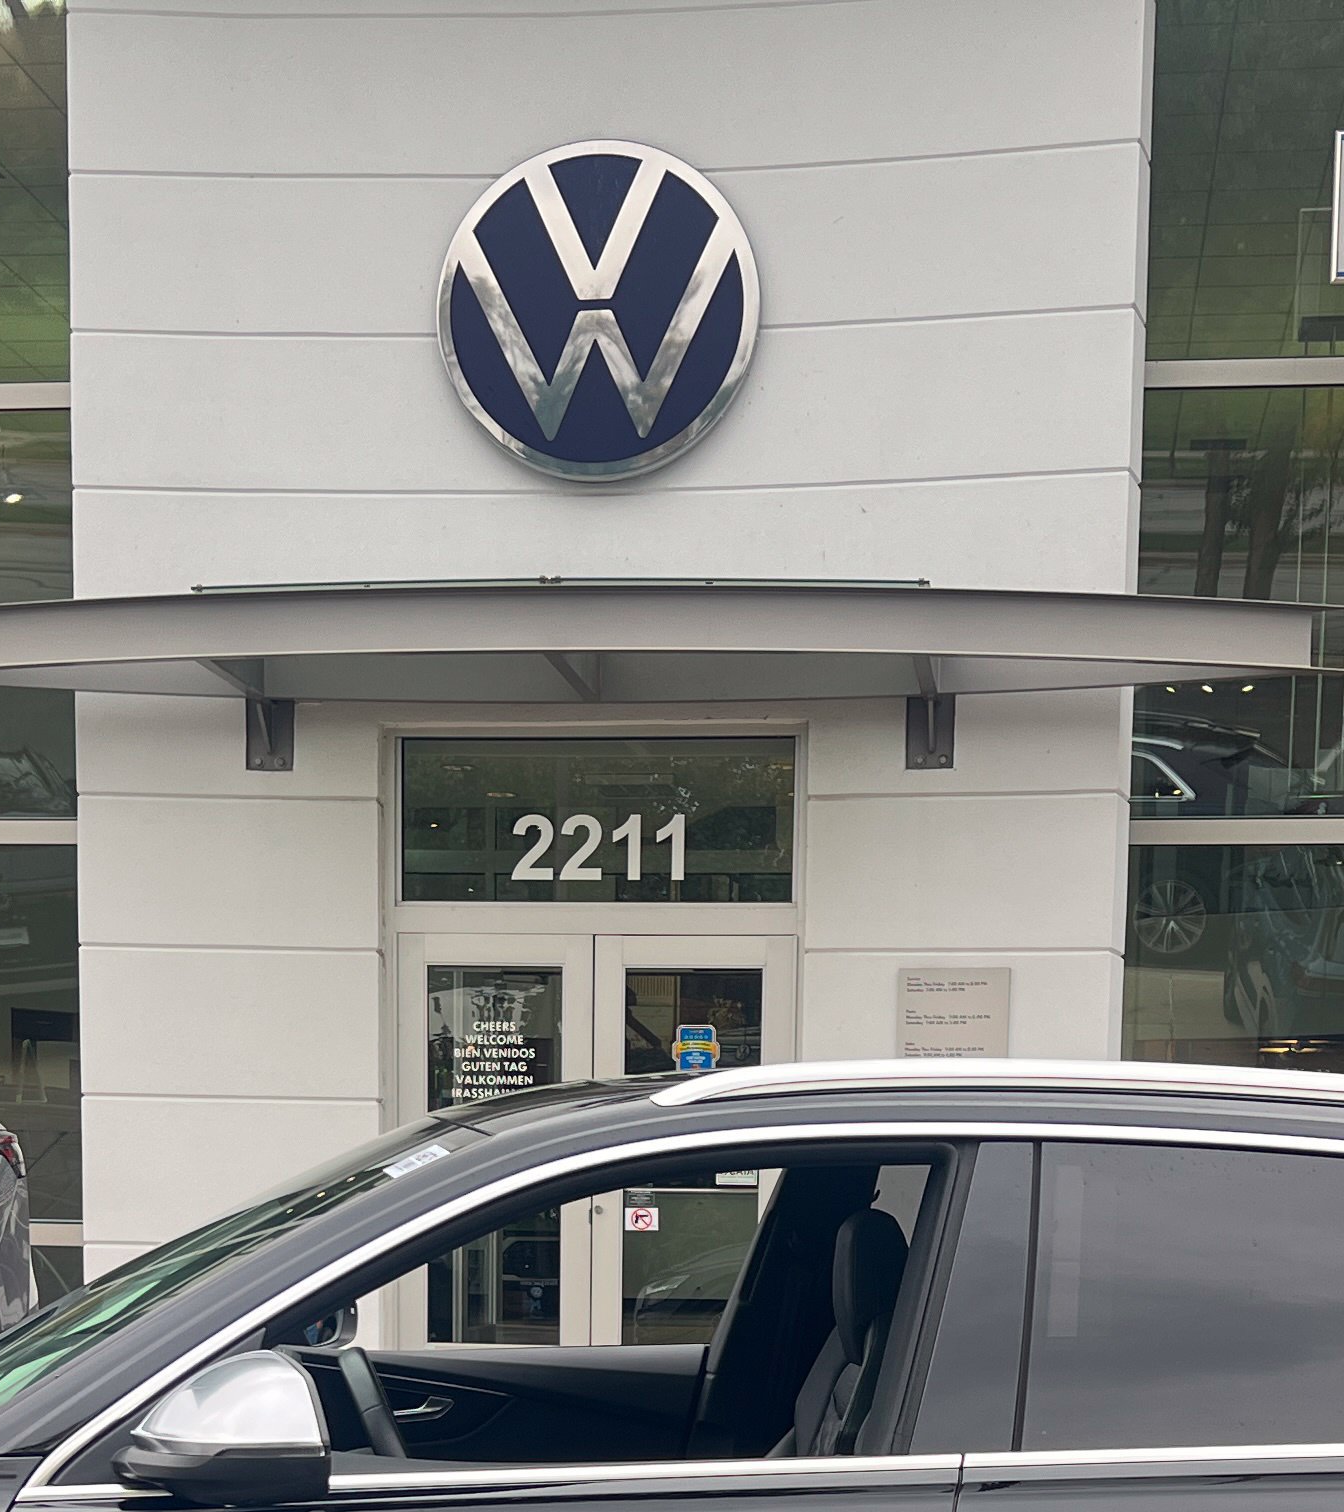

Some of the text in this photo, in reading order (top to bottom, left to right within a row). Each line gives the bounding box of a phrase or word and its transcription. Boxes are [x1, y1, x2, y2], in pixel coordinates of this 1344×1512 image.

[450, 146, 748, 446] VW
[510, 813, 686, 881] 2211
[472, 1021, 516, 1032] CHEERS
[465, 1034, 524, 1045] WELCOME
[454, 1047, 536, 1059] BIEN VENIDOS
[461, 1061, 528, 1072] GUTEN TAG
[455, 1074, 534, 1086] VALKOMMEN
